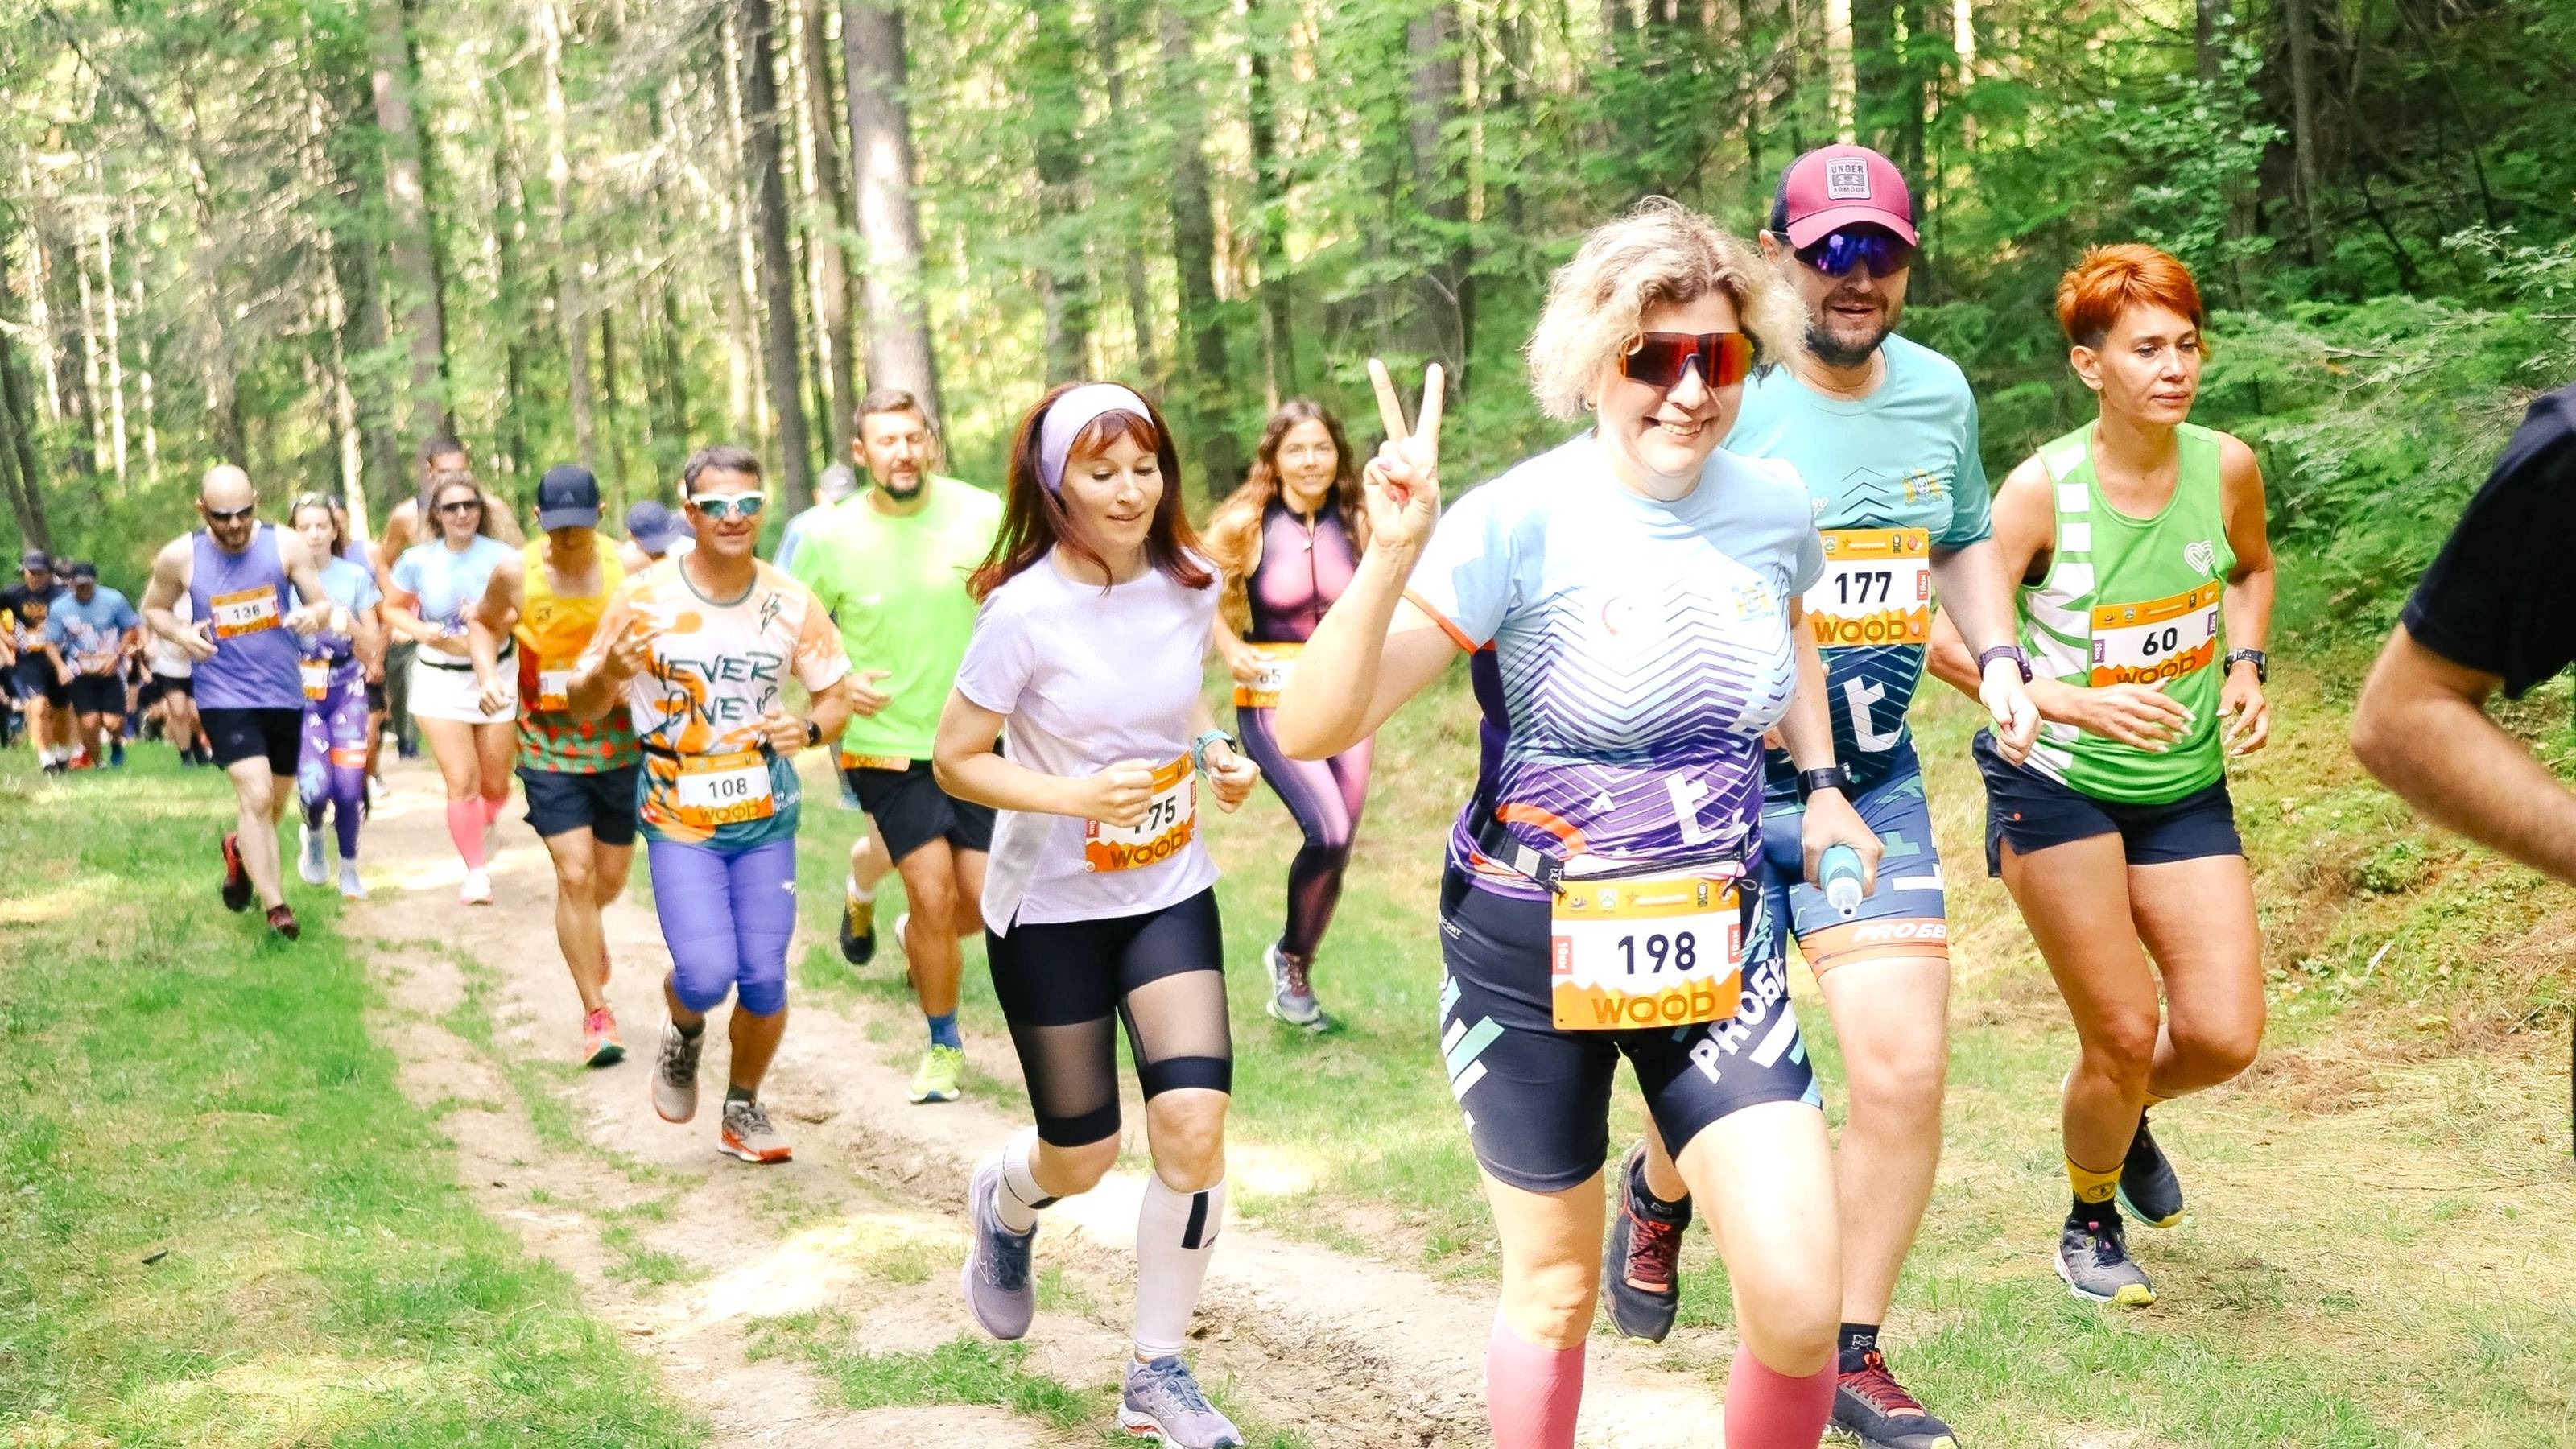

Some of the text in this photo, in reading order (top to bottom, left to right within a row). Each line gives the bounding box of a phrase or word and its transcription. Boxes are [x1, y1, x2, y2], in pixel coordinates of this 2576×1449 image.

[1831, 164, 1864, 174] UNDER
[1811, 497, 1829, 508] RO
[1835, 571, 1892, 604] 177
[233, 604, 261, 620] 138
[1814, 619, 1907, 642] WOOD
[2142, 627, 2178, 657] 60
[650, 650, 784, 691] NEVER
[2116, 654, 2197, 685] WOOD
[708, 777, 749, 799] 108
[698, 803, 761, 822] WOOD
[1134, 795, 1177, 835] 75
[1110, 831, 1185, 869] WOOD
[1617, 931, 1696, 975] 198
[1591, 990, 1716, 1025] WOOD
